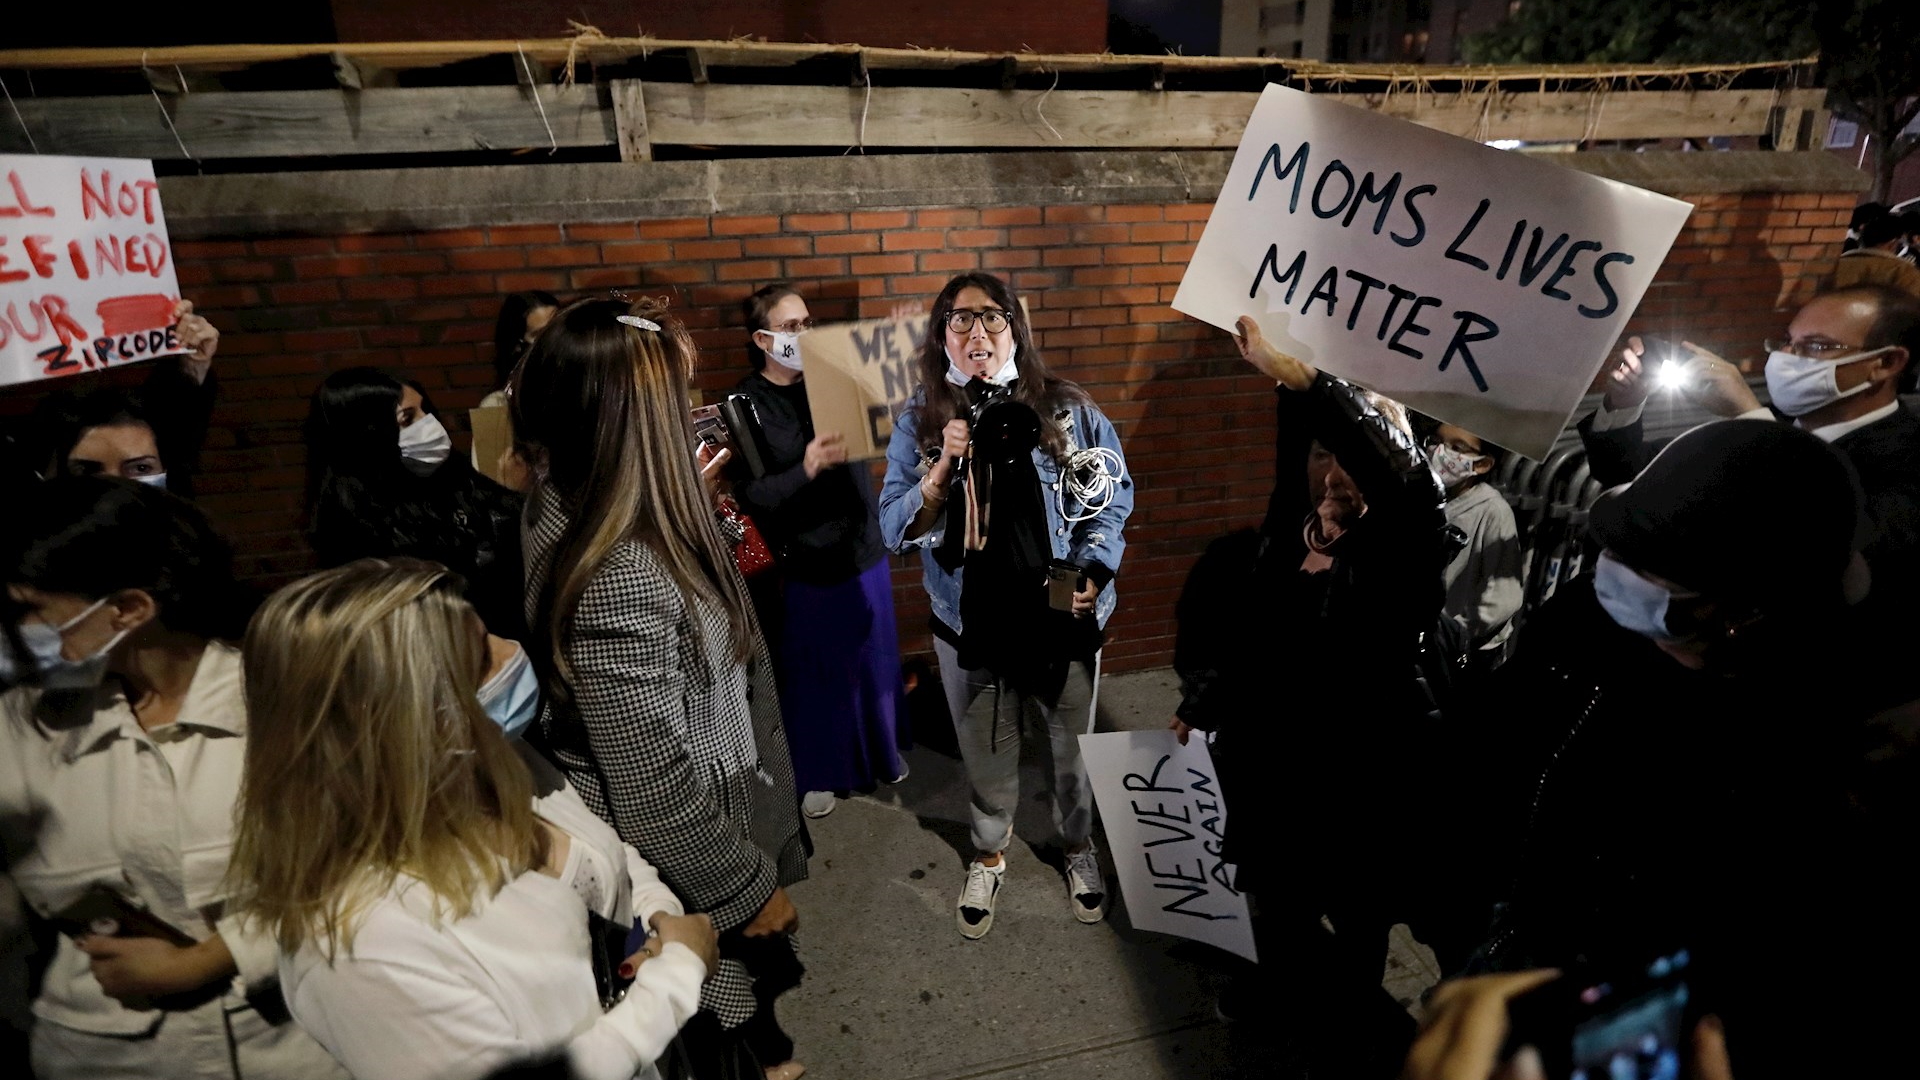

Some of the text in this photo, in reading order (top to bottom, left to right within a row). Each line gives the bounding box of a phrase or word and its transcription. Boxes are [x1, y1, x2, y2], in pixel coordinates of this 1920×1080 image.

[81, 166, 158, 225] NOT
[1249, 141, 1635, 319] MOMS LIVES
[850, 323, 902, 365] WE
[1249, 243, 1500, 393] MATTER
[1122, 754, 1215, 921] NEVER
[1186, 767, 1240, 897] AGAIN
